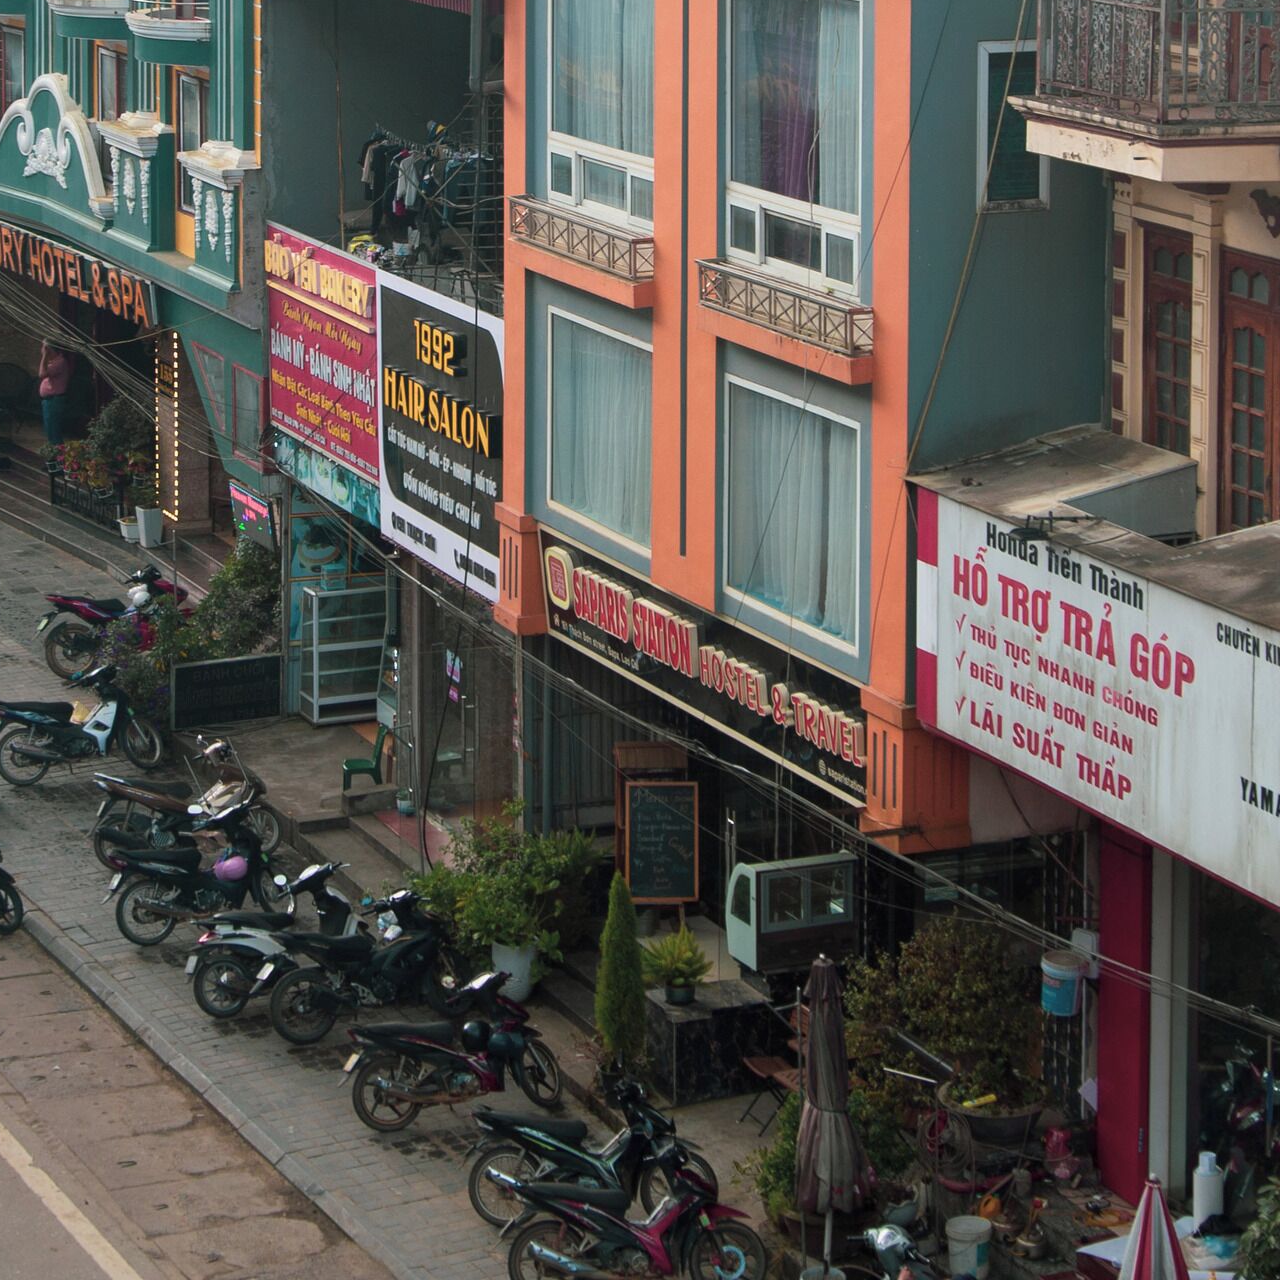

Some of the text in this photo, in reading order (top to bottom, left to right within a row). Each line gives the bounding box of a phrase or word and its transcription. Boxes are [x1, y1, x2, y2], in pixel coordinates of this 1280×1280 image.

[28, 235, 89, 304] HOTEL
[91, 261, 106, 308] &
[108, 268, 149, 328] SPA
[291, 247, 320, 295] YẾN
[320, 265, 374, 318] BAKERY
[271, 322, 292, 364] BÁNH
[309, 344, 332, 385] BÁNH
[333, 359, 353, 391] SINH
[354, 368, 375, 412] NHẬT
[413, 320, 455, 376] 1992
[384, 367, 489, 458] HAIR SALON
[987, 522, 1144, 610] Honda Tiến Thành
[572, 568, 631, 644] SAPARIS
[632, 598, 697, 678] STATION
[699, 646, 768, 716] HOSTEL
[771, 683, 790, 726] &
[791, 692, 867, 768] TRAVEL
[953, 546, 1195, 698] HỖ TRỢ TRẢ GÓP
[1216, 622, 1260, 657] CHUYÊN
[970, 624, 1159, 727] THỦ TỤC NHANH CHÓNG
[970, 661, 1133, 755] ĐIỀU KIỆN ĐƠN GIẢN
[970, 701, 1132, 800] LÃI SUẤT THẤP
